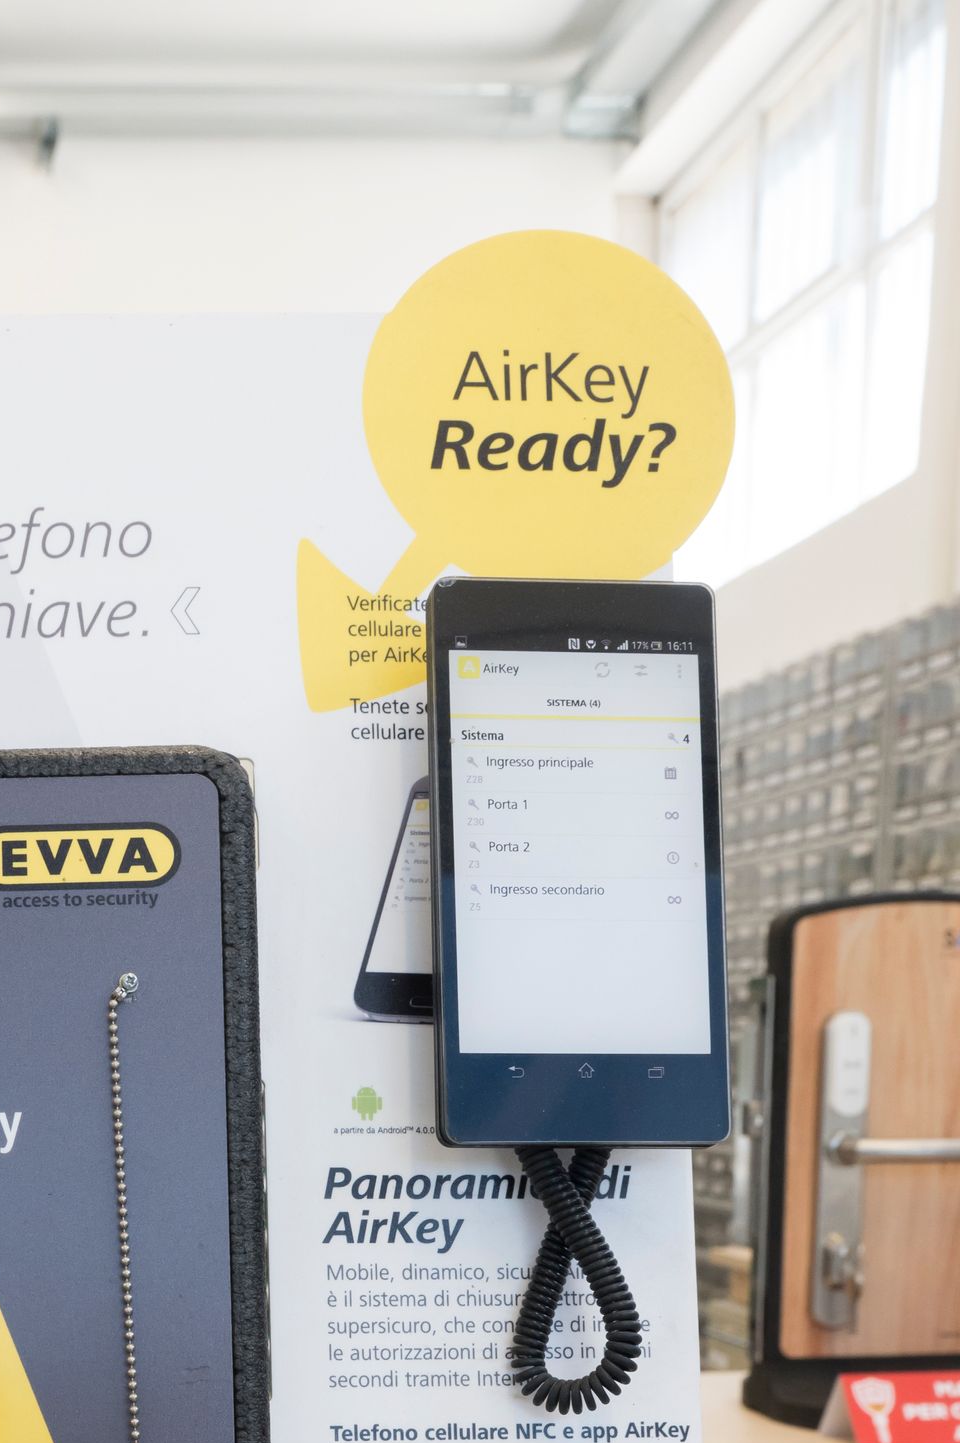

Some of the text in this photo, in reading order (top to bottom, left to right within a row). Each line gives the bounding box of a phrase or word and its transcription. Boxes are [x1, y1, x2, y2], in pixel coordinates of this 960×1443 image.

[452, 350, 650, 419] AirKey
[430, 418, 677, 488] Ready?
[347, 594, 428, 614] Verificate
[348, 620, 422, 638] cellulare
[632, 640, 693, 651] 17% 16:11
[349, 650, 378, 667] per
[483, 663, 519, 676] AirKey
[349, 698, 410, 715] Tenete
[547, 699, 601, 708] SISTEMA (4)
[351, 723, 425, 741] cellulare
[461, 730, 504, 741] Sistema
[683, 734, 690, 744] 4
[486, 756, 594, 771] Ingresso principale
[488, 799, 527, 810] Porta 1
[489, 841, 530, 853] Porta 2
[1, 837, 158, 877] EVVA
[2, 890, 159, 909] access to security
[490, 884, 605, 898] Ingresso secondario
[340, 1127, 365, 1136] partire
[324, 1165, 632, 1201] Panorami di
[322, 1210, 464, 1254] AirKey
[327, 1263, 489, 1283] Mobile, dinamico,
[329, 1342, 498, 1361] le autorizzazioni di
[330, 1421, 690, 1443] Telefono cellulare NFC e app AirKey
